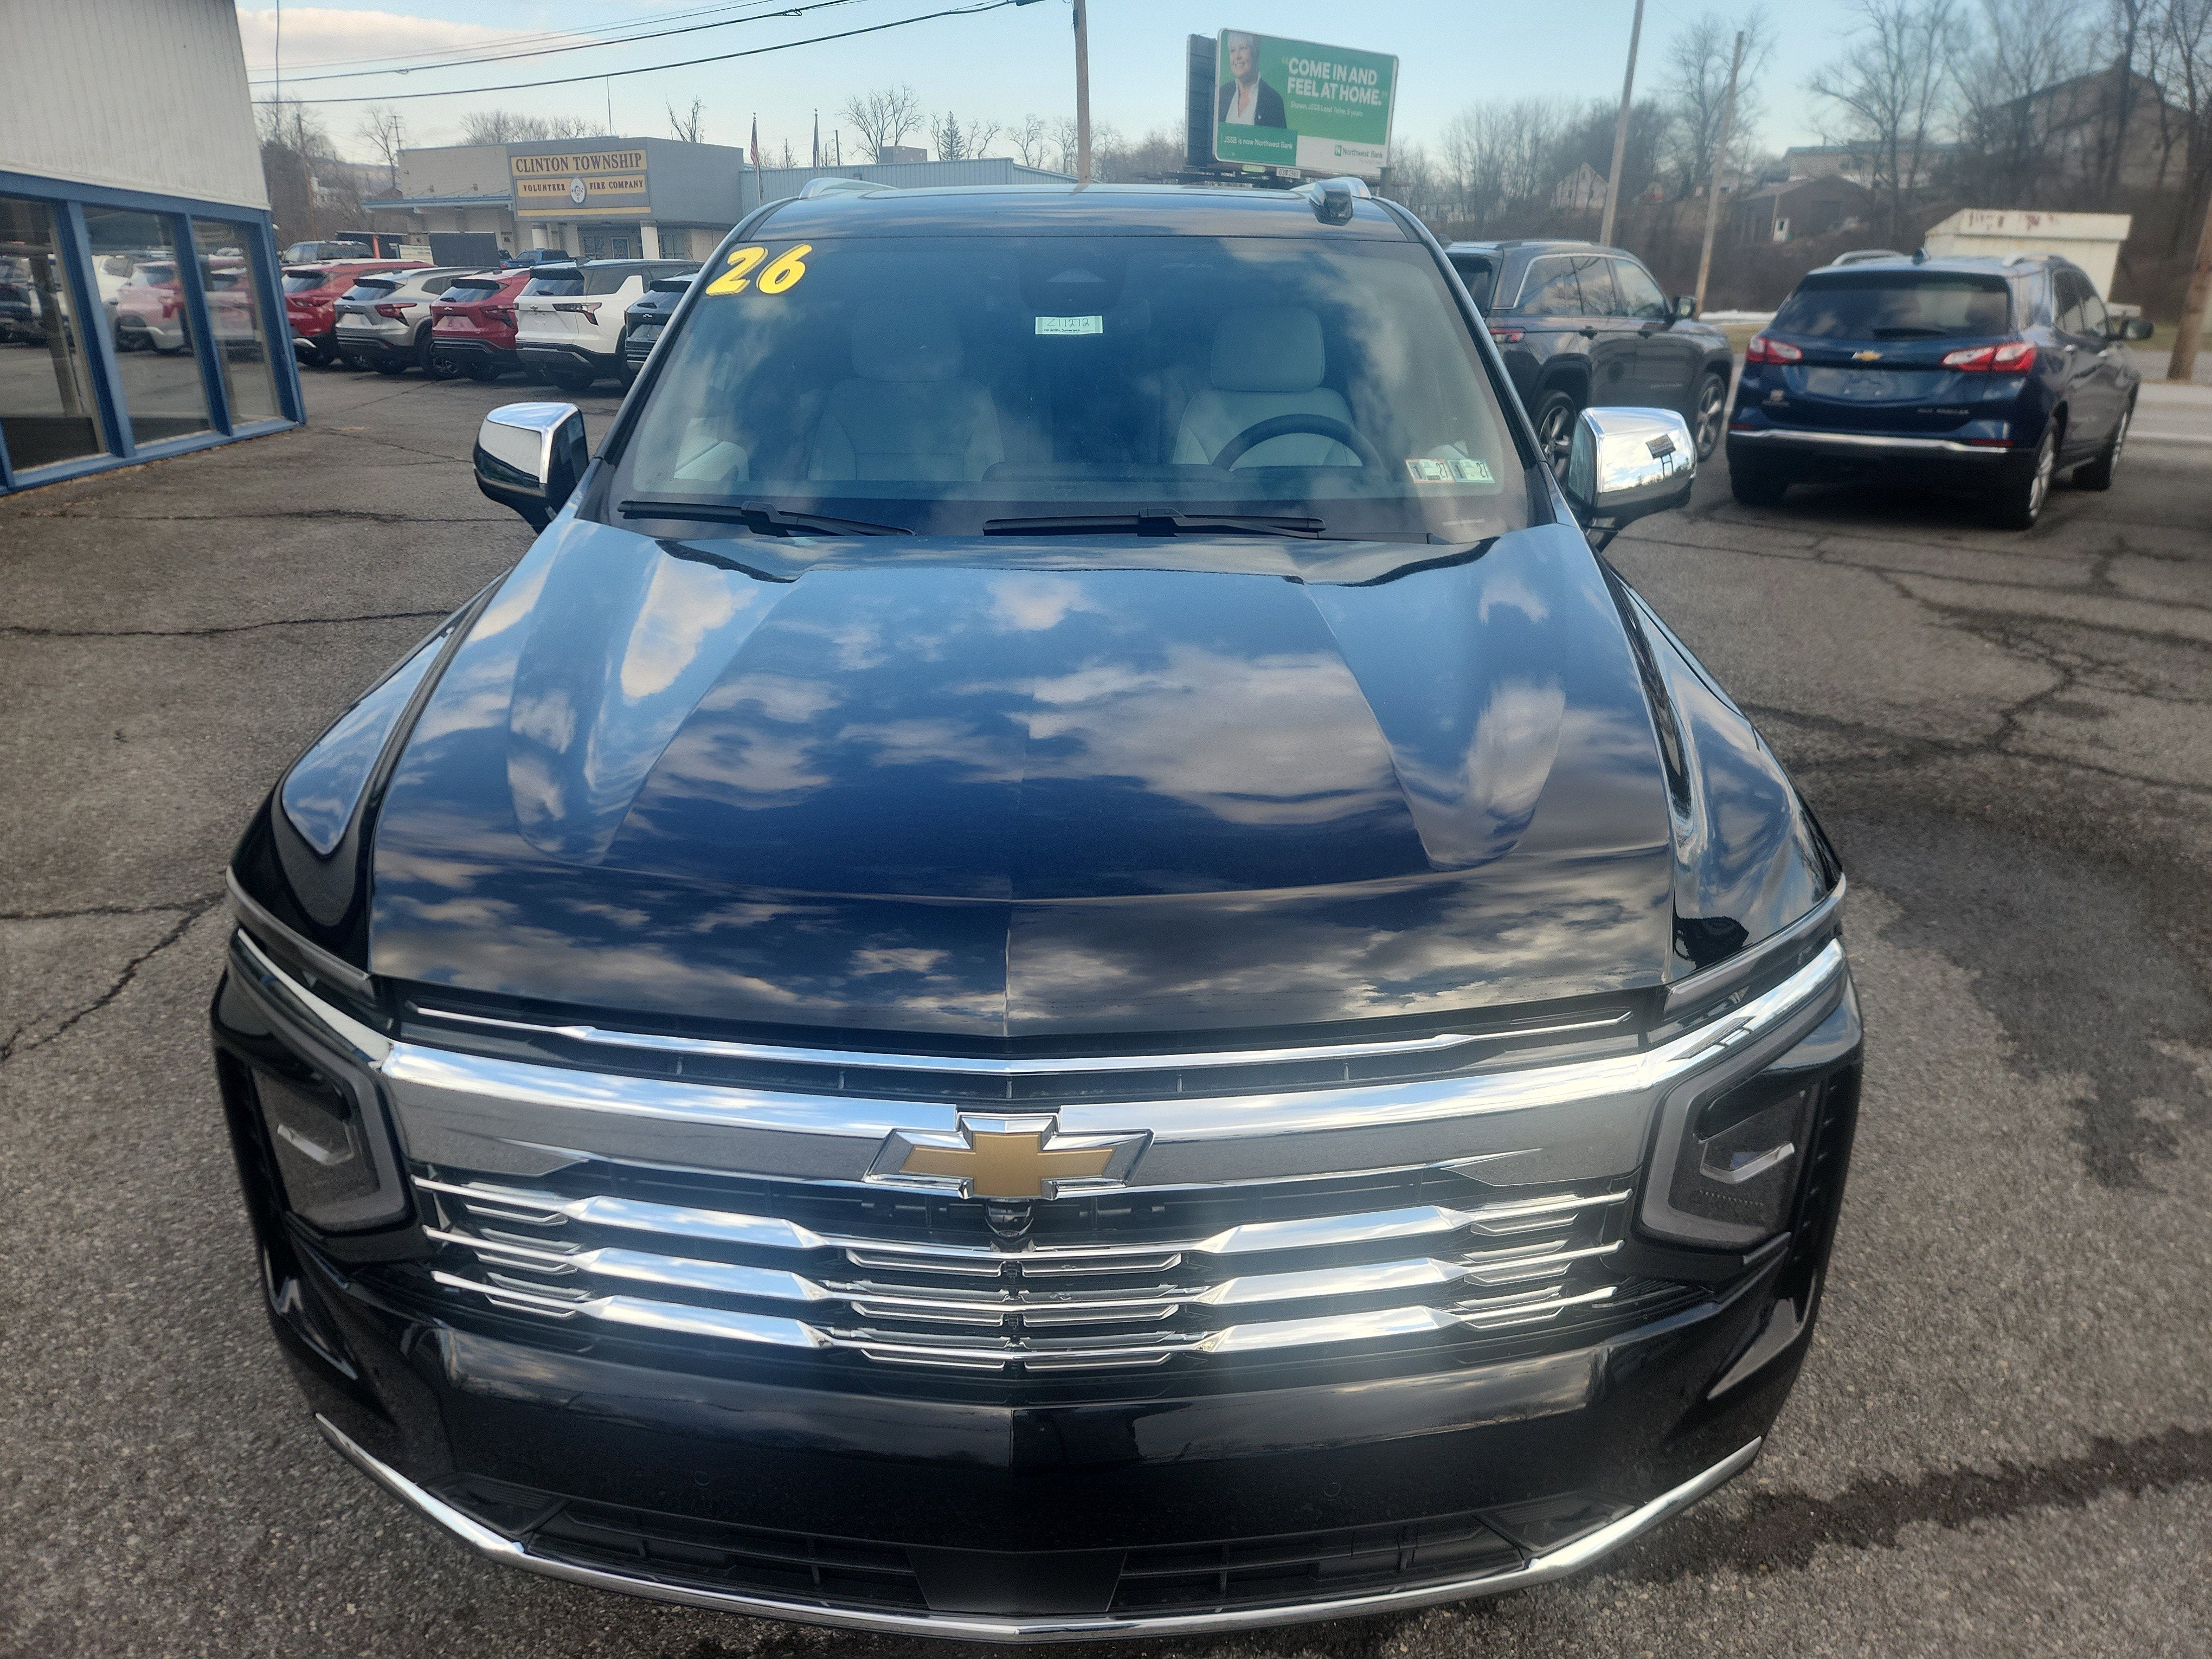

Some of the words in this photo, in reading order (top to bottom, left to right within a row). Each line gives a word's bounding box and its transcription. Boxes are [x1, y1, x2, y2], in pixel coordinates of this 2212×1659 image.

[1333, 63, 1347, 81] IN
[1348, 66, 1378, 86] AND
[1287, 77, 1319, 98] FEEL
[1320, 82, 1339, 100] AT
[1255, 139, 1280, 147] Northwest
[1342, 148, 1369, 157] Northwest
[516, 157, 569, 173] CLINTON
[573, 153, 642, 171] TOWNSHIP
[523, 183, 566, 192] VOLUNTEER
[589, 181, 606, 190] FIRE
[609, 180, 644, 189] COMPANY
[705, 243, 812, 296] 26
